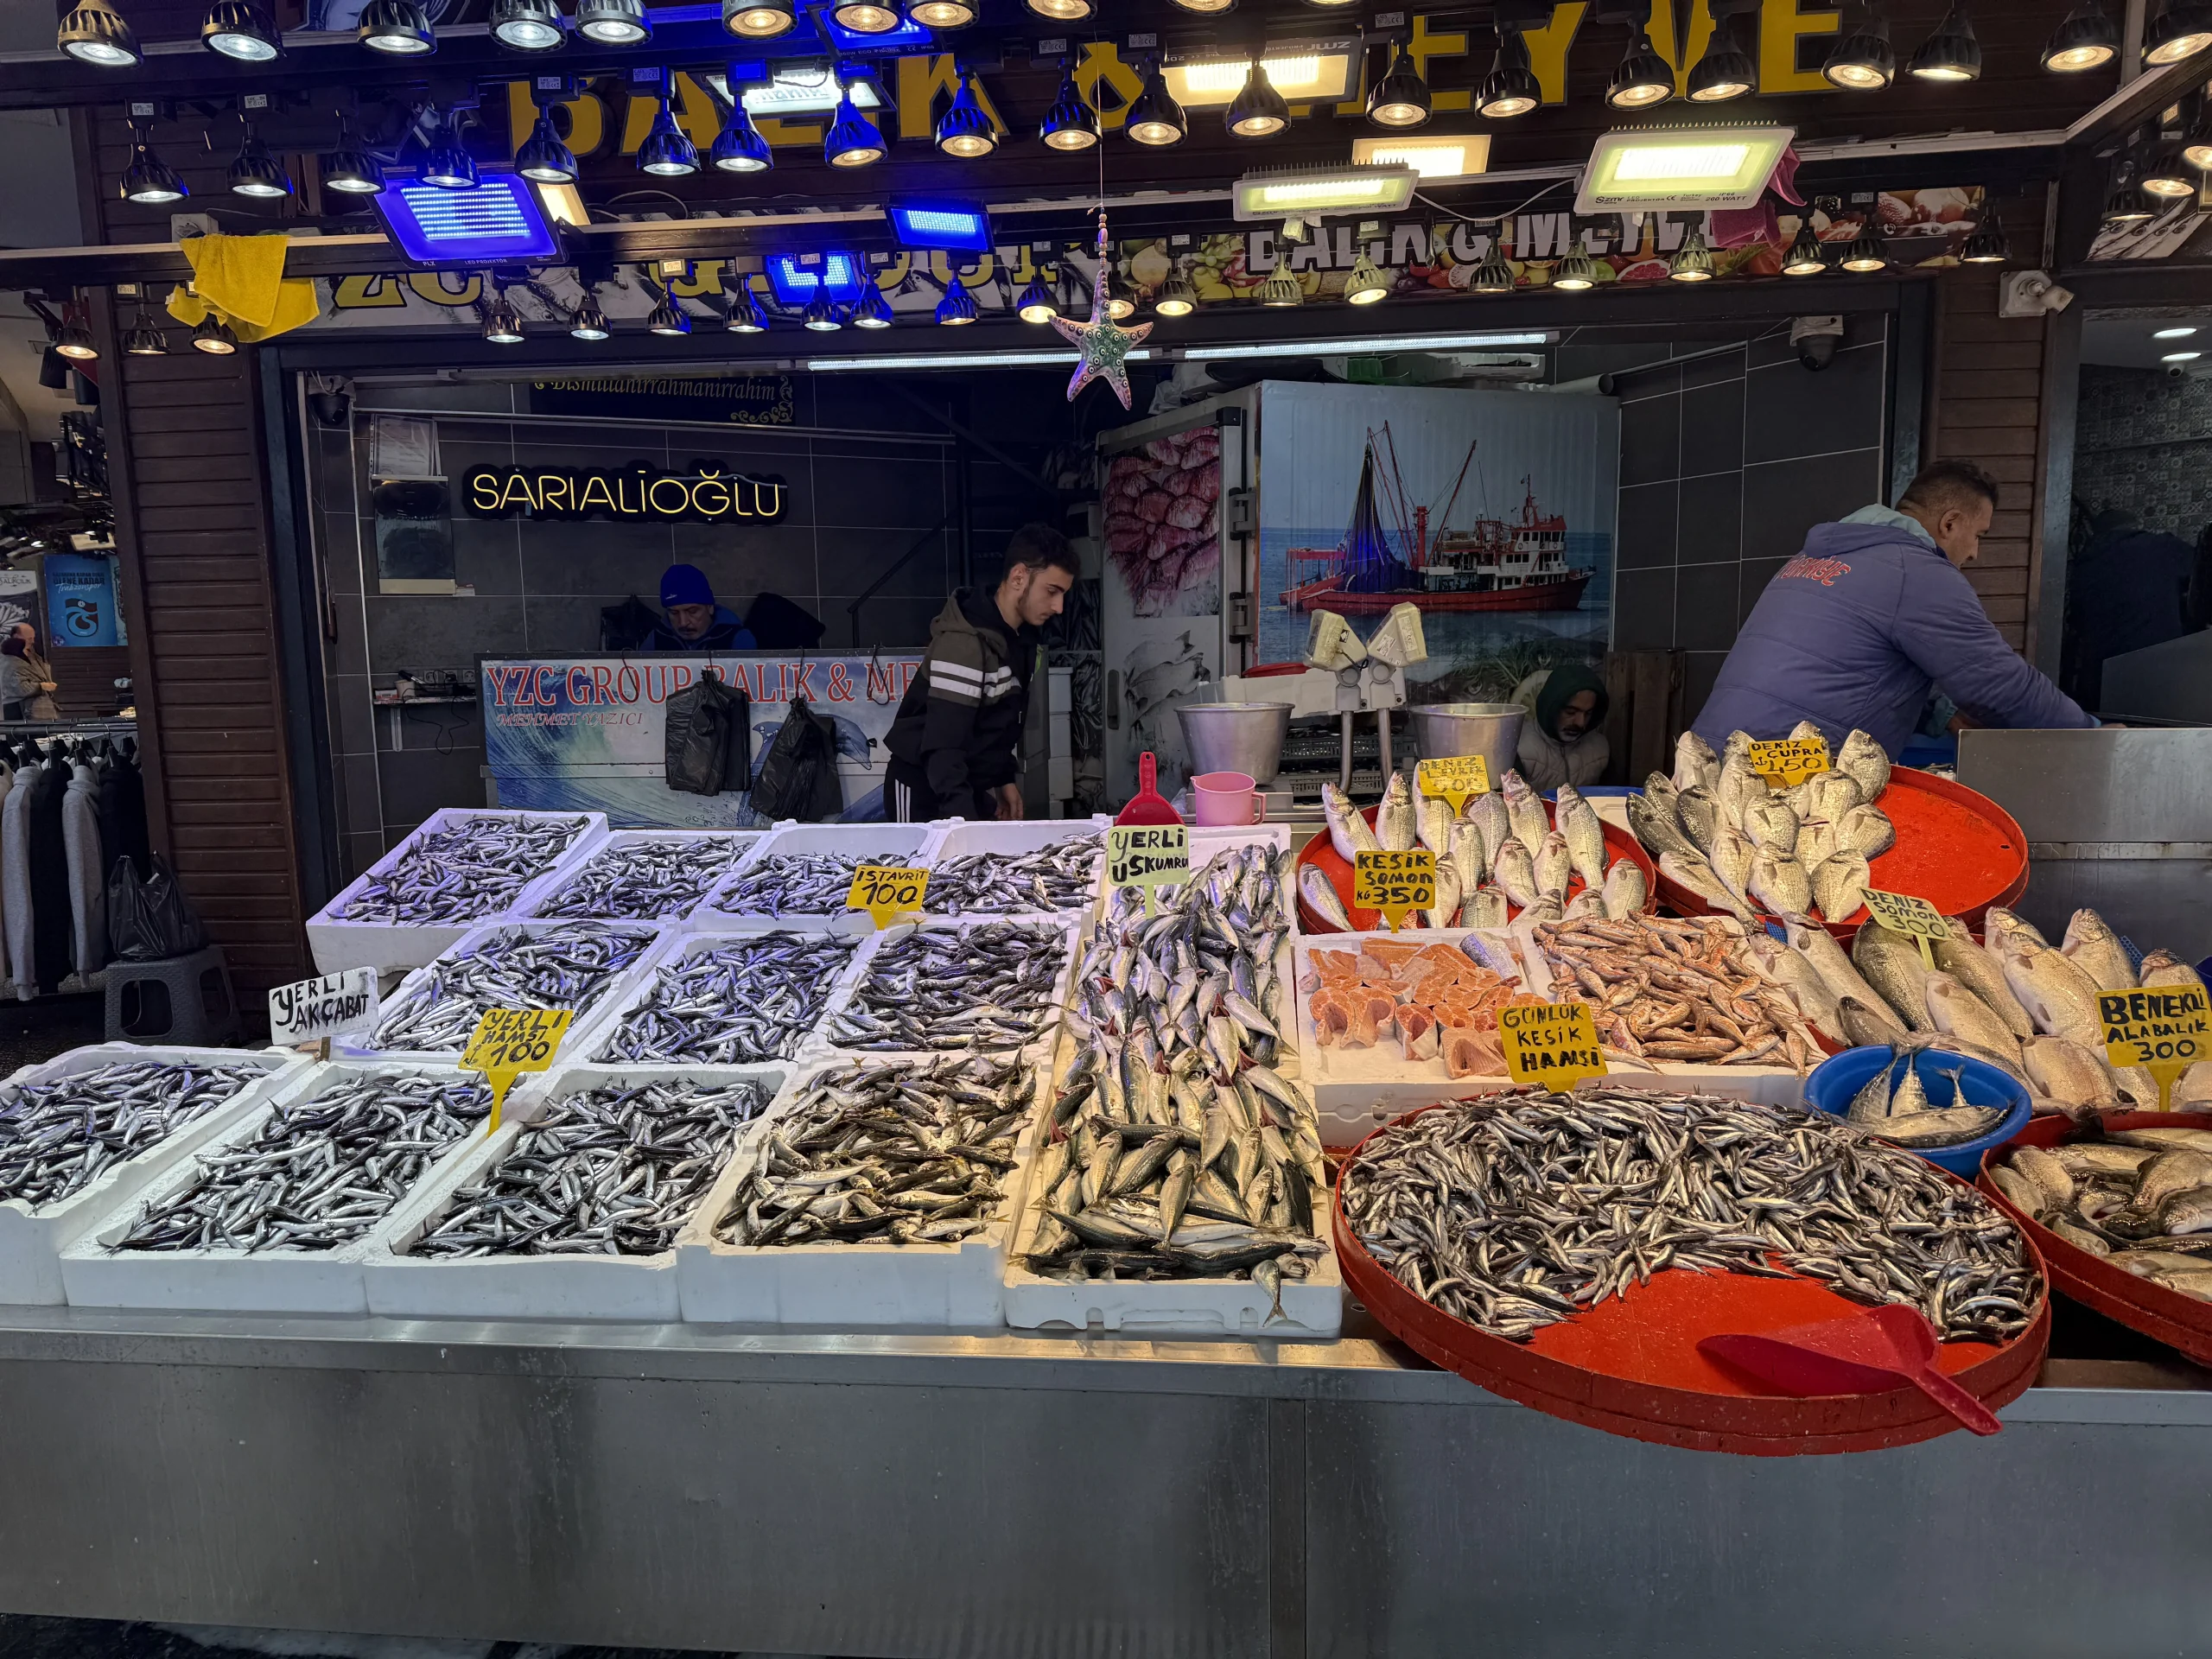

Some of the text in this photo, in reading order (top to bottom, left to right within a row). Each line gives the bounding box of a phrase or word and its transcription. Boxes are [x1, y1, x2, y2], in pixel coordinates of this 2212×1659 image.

[509, 54, 1009, 165] BAK
[473, 468, 779, 518] SARIALİOĞLU
[486, 664, 556, 707] YZC
[565, 663, 692, 705] GROUP
[827, 663, 855, 702] &
[1111, 854, 1189, 882] USKUMRU
[861, 881, 918, 906] 100
[1372, 887, 1430, 906] 350
[1888, 914, 1945, 937] 300
[289, 994, 370, 1033] AKÇABAT
[1503, 1003, 1584, 1029] GÜNLÜK
[1516, 1026, 1582, 1047] KESİK
[2107, 1019, 2210, 1044] ALABALIK
[490, 1040, 550, 1067] 100
[1520, 1046, 1599, 1072] HAMSİ
[2133, 1039, 2196, 1062] 300
